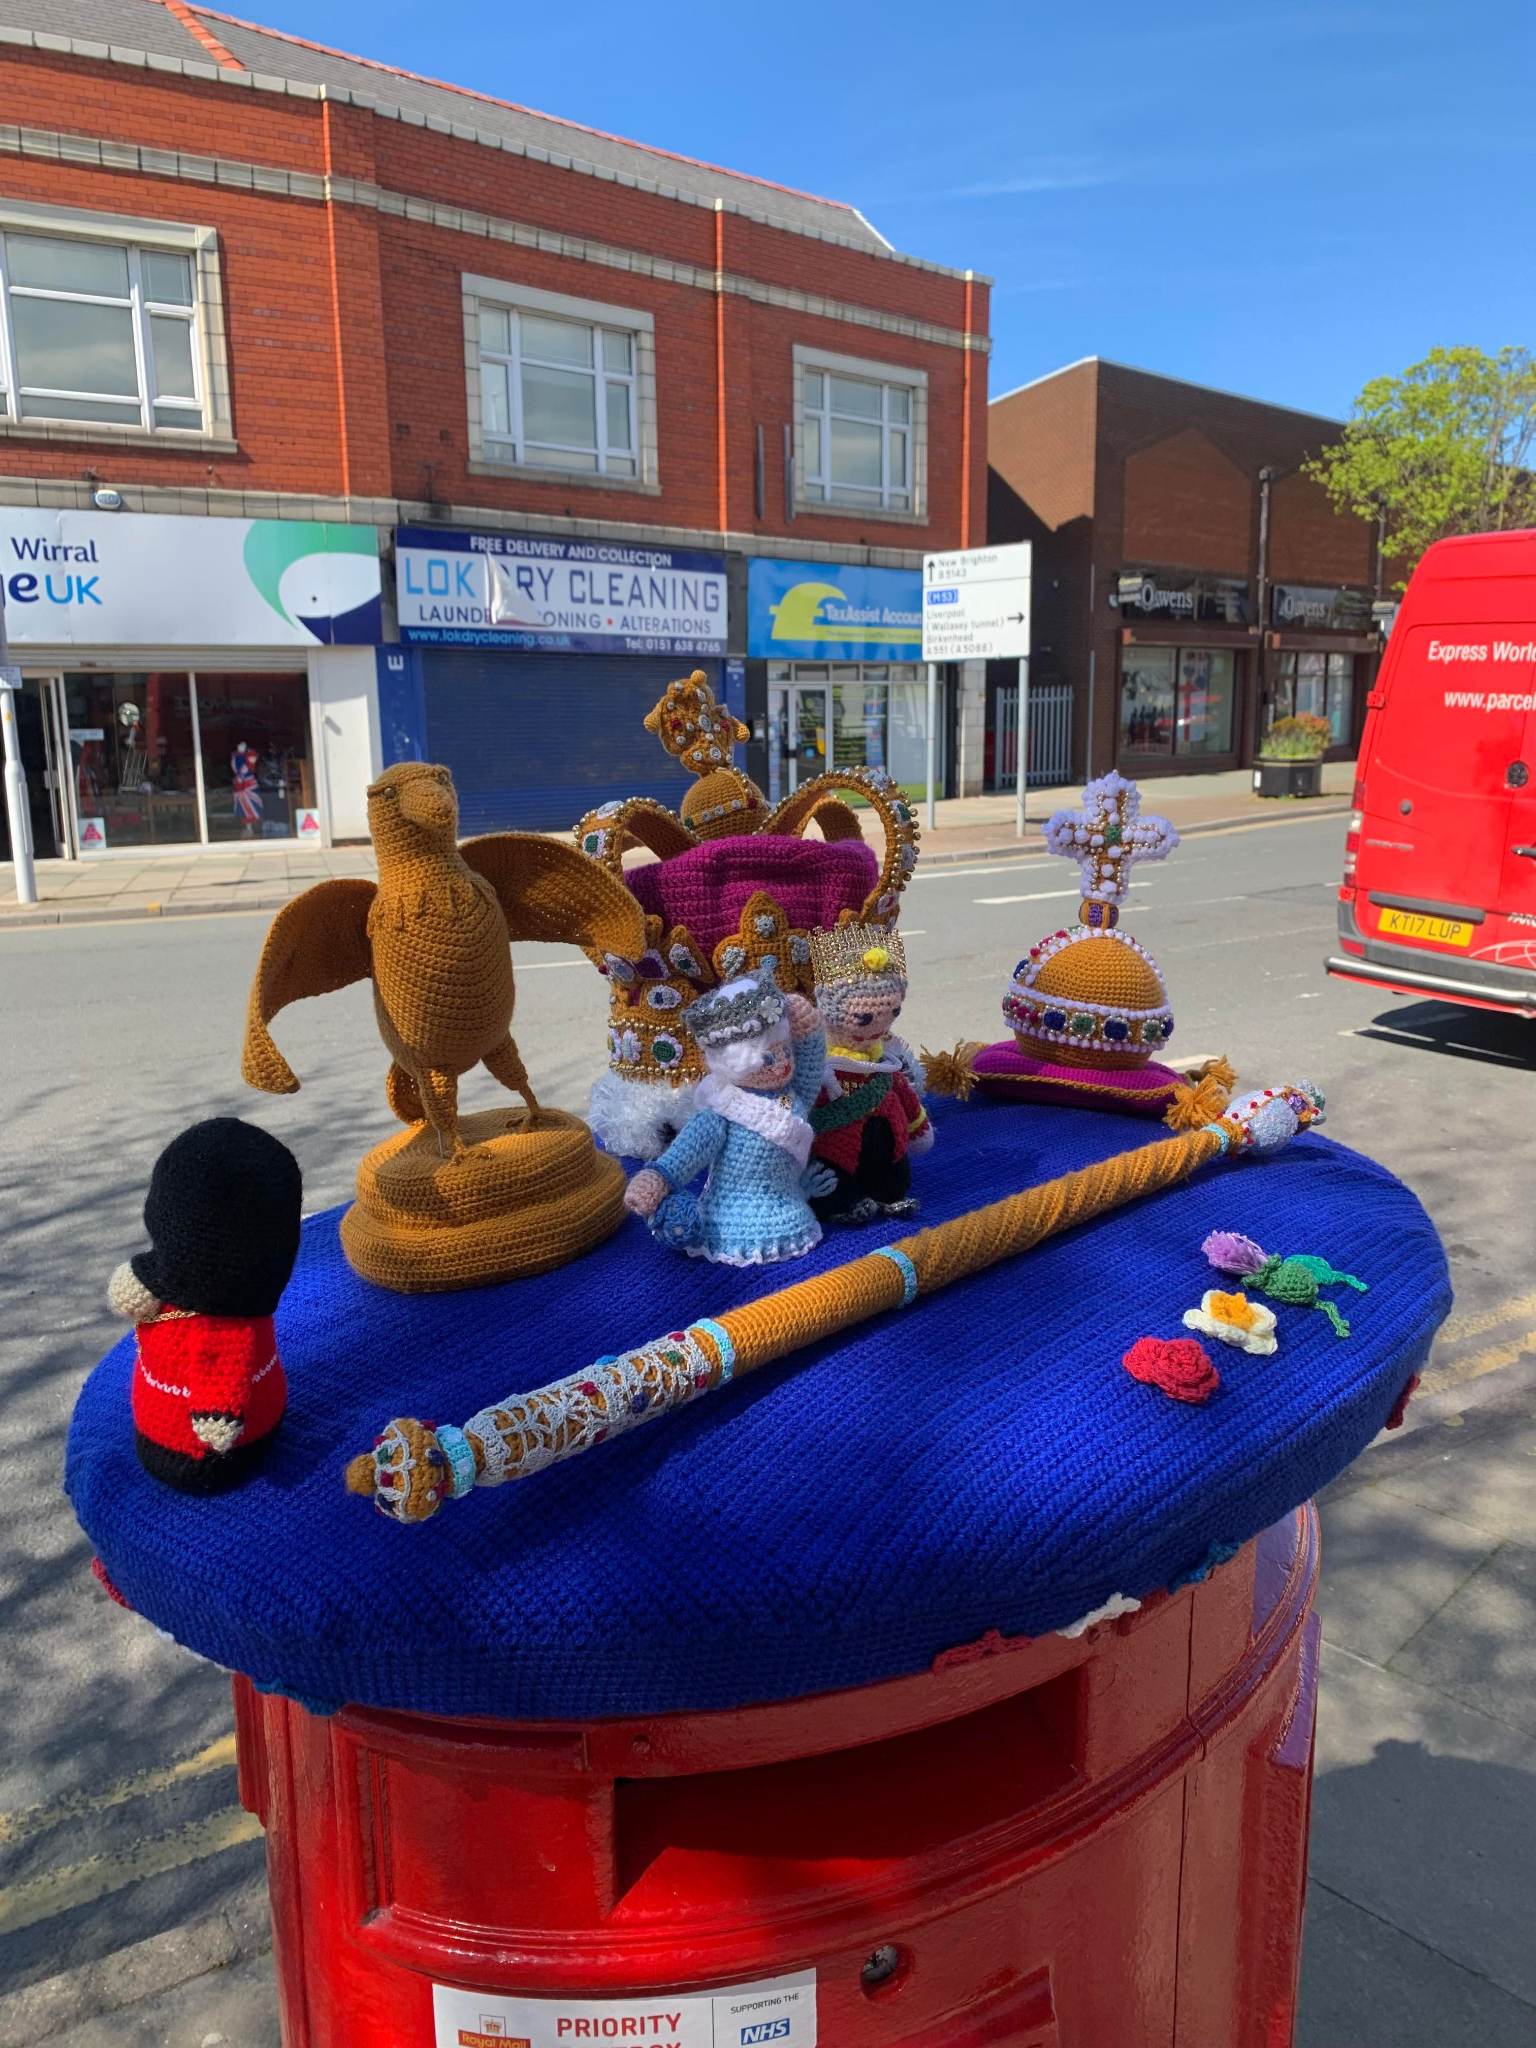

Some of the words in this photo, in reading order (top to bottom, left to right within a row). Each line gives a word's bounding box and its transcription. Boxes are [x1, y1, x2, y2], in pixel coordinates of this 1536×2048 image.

[10, 537, 98, 563] Wirral
[470, 536, 502, 553] FREE
[506, 540, 565, 558] DELIVERY
[568, 545, 596, 559] AND
[598, 548, 672, 566] COLLECTION
[406, 557, 476, 598] LOK
[501, 564, 554, 602] RY
[569, 570, 719, 612] CLEANING
[538, 610, 601, 628] ONING
[620, 615, 711, 634] ALTERATIONS
[927, 608, 966, 620] Liverpool
[407, 629, 571, 646] www.lokdrycleaning.co.uk
[646, 638, 671, 650] 0151
[927, 633, 974, 645] Birkenhead
[1428, 640, 1488, 665] Express
[1390, 914, 1425, 934] KT17
[1428, 921, 1462, 940] LUP
[730, 1997, 782, 2015] SUPPORTING
[784, 1992, 800, 2003] THE
[557, 2012, 681, 2037] PRIORITY
[742, 2020, 788, 2044] NHS
[462, 2034, 496, 2048] Royal
[500, 2037, 527, 2048] Mail
